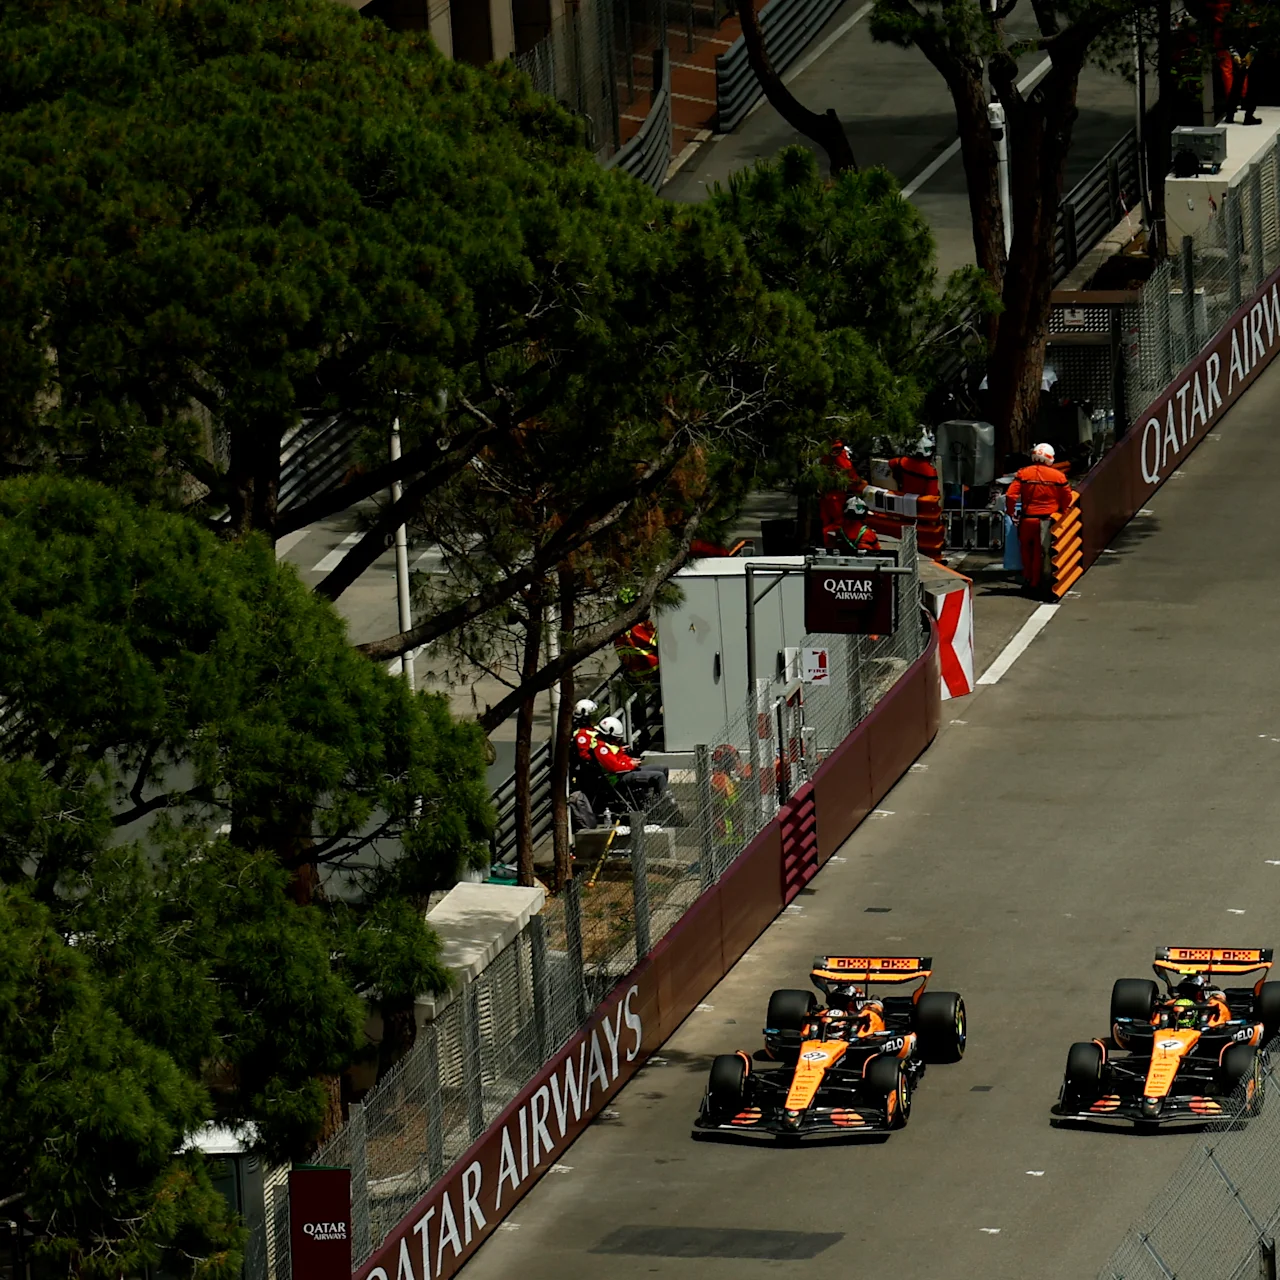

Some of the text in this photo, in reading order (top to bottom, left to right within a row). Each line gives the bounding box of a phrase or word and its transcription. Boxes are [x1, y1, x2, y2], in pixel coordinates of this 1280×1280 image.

[1141, 352, 1223, 484] QATAR
[824, 579, 873, 593] QATAR
[835, 592, 873, 600] AIRWAYS
[495, 984, 642, 1211] AIRWAYS
[303, 1222, 346, 1236] QATAR
